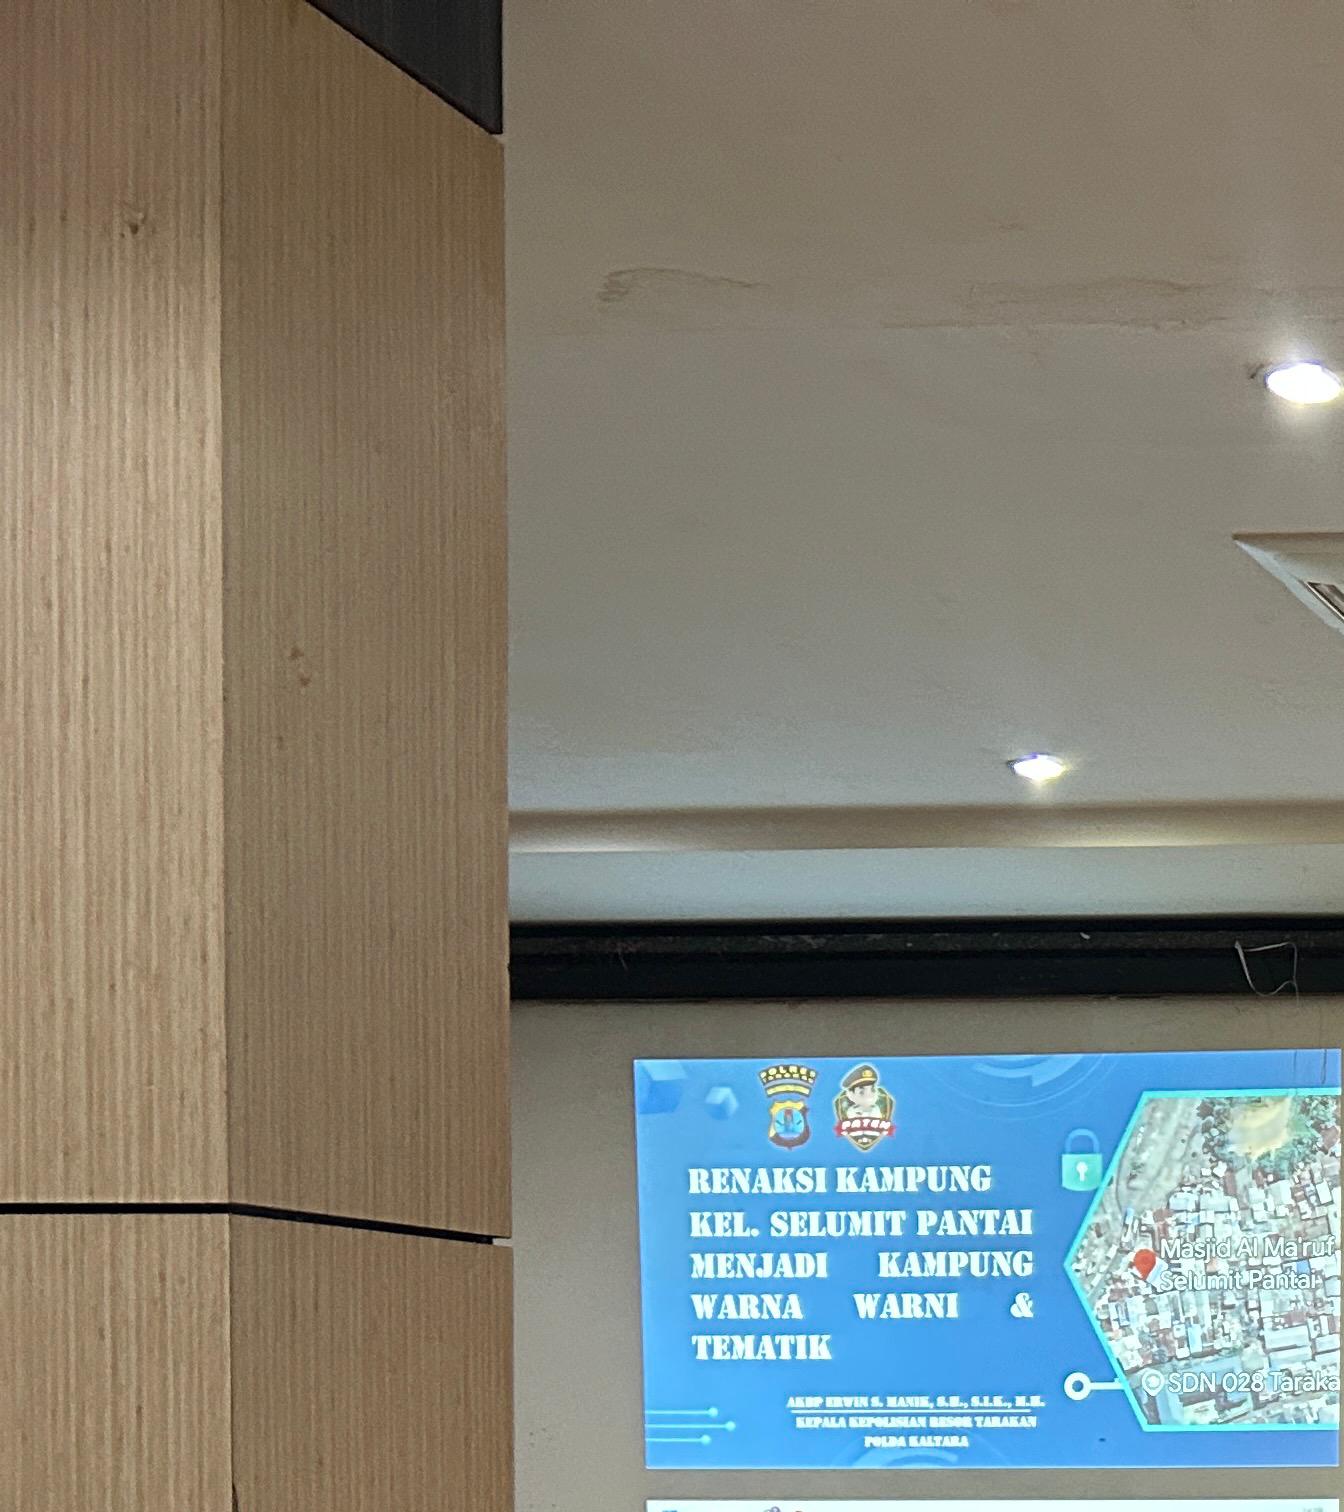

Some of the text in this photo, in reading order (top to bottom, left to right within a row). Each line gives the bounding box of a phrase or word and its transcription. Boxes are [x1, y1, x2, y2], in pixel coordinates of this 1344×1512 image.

[689, 1165, 992, 1194] RENAKSI KAMPUNG
[689, 1209, 1033, 1237] KEL. SELUMIT PANTAI
[1160, 1235, 1336, 1266] Masjid Al Ma'ruf
[690, 1250, 1034, 1279] MENJADI KAMPUNG
[1160, 1269, 1316, 1291] Selumit Pantai
[690, 1292, 1035, 1320] WARNA WARNI &
[691, 1334, 832, 1360] TEMATIK
[1168, 1372, 1217, 1393] SDN
[1222, 1372, 1265, 1393] 028
[787, 1396, 823, 1408] AKBP
[826, 1396, 869, 1408] ERWIN
[796, 1416, 1037, 1429] KEPALA KEPOLISIAN RESOR TARAKAN
[865, 1436, 969, 1448] POLDA KALTARA
